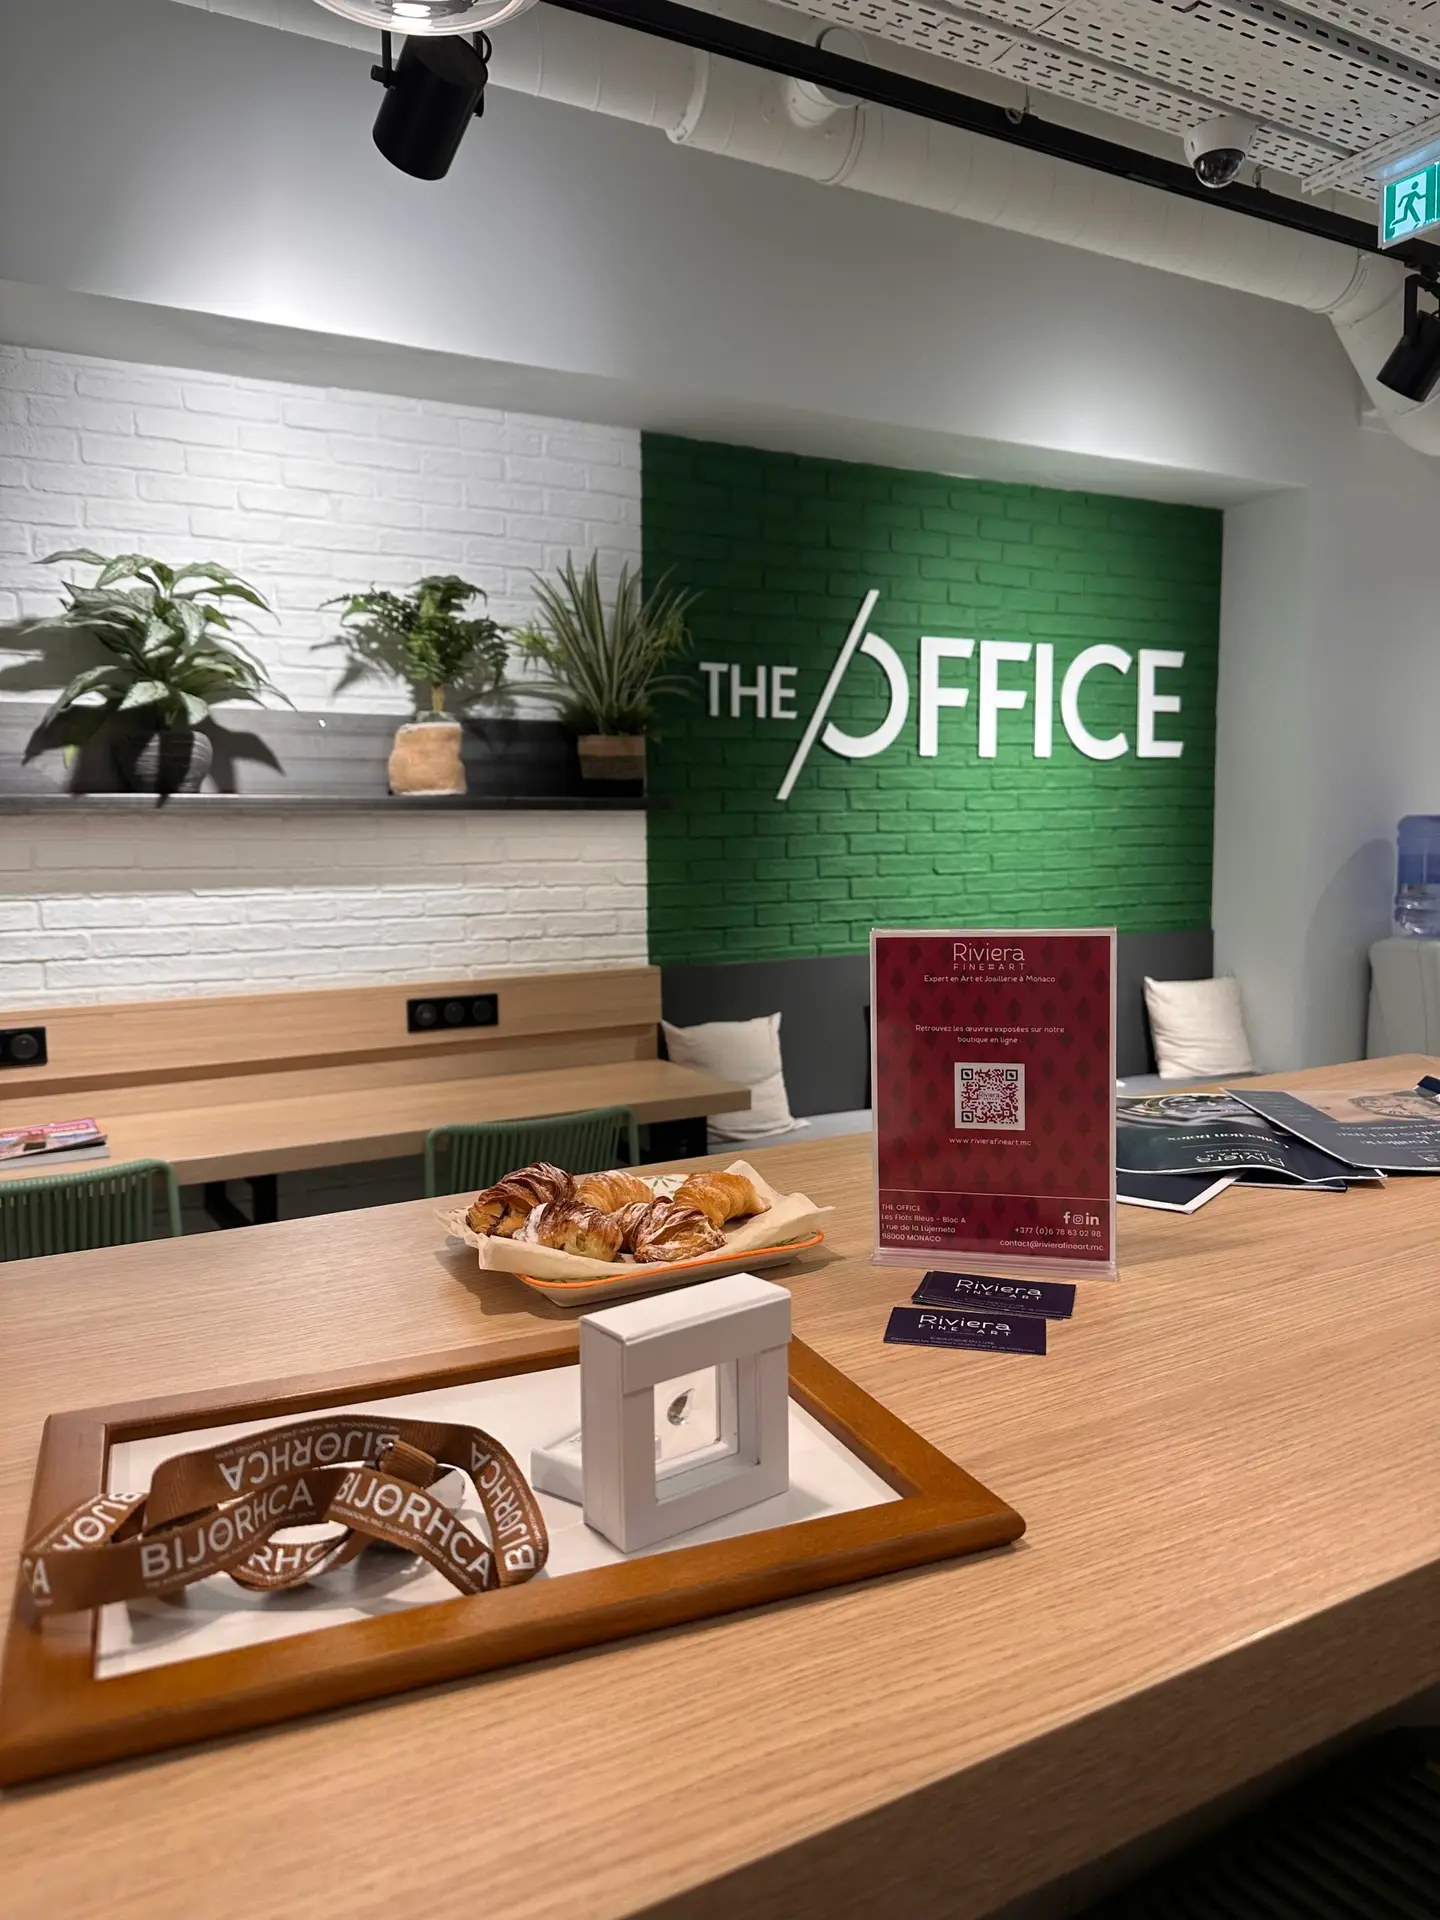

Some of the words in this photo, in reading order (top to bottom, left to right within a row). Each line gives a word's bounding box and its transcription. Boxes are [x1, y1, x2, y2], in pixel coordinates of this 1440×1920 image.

[698, 661, 798, 720] THE
[953, 942, 1026, 962] Riviera
[953, 963, 985, 971] FINE
[998, 963, 1026, 971] ART
[924, 975, 949, 984] Expert
[960, 975, 974, 983] Art
[975, 975, 984, 983] et
[984, 975, 1018, 984] Joaillerie
[1025, 975, 1056, 984] Monaco
[915, 1024, 952, 1033] Retrouvez
[953, 1025, 964, 1033] les
[965, 1026, 993, 1034] œuvres
[994, 1025, 1029, 1035] exposées
[1044, 1026, 1065, 1034] notre
[957, 1036, 989, 1045] boutique
[1000, 1036, 1018, 1046] ligne
[881, 1203, 894, 1211] THE
[896, 1204, 921, 1212] OFFICE
[895, 1213, 912, 1221] Flots
[881, 1232, 905, 1240] 98000
[906, 1234, 942, 1242] MONACO
[1014, 1226, 1033, 1235] +377
[1035, 1225, 1054, 1235] (0)6
[1067, 1228, 1077, 1236] 63
[1091, 1230, 1102, 1238] 98
[999, 1239, 1104, 1252] contact@rivierafineart.mc
[954, 1288, 993, 1296] FINE
[1008, 1293, 1042, 1301] ART
[956, 1279, 1042, 1297] Riviera
[919, 1314, 1012, 1332] Riviera
[918, 1323, 959, 1332] FINE
[976, 1329, 1012, 1337] ART
[471, 1441, 536, 1571] BIJORHCA
[139, 1478, 315, 1579] BIJORHCA
[334, 1472, 491, 1587] BIJORHCA
